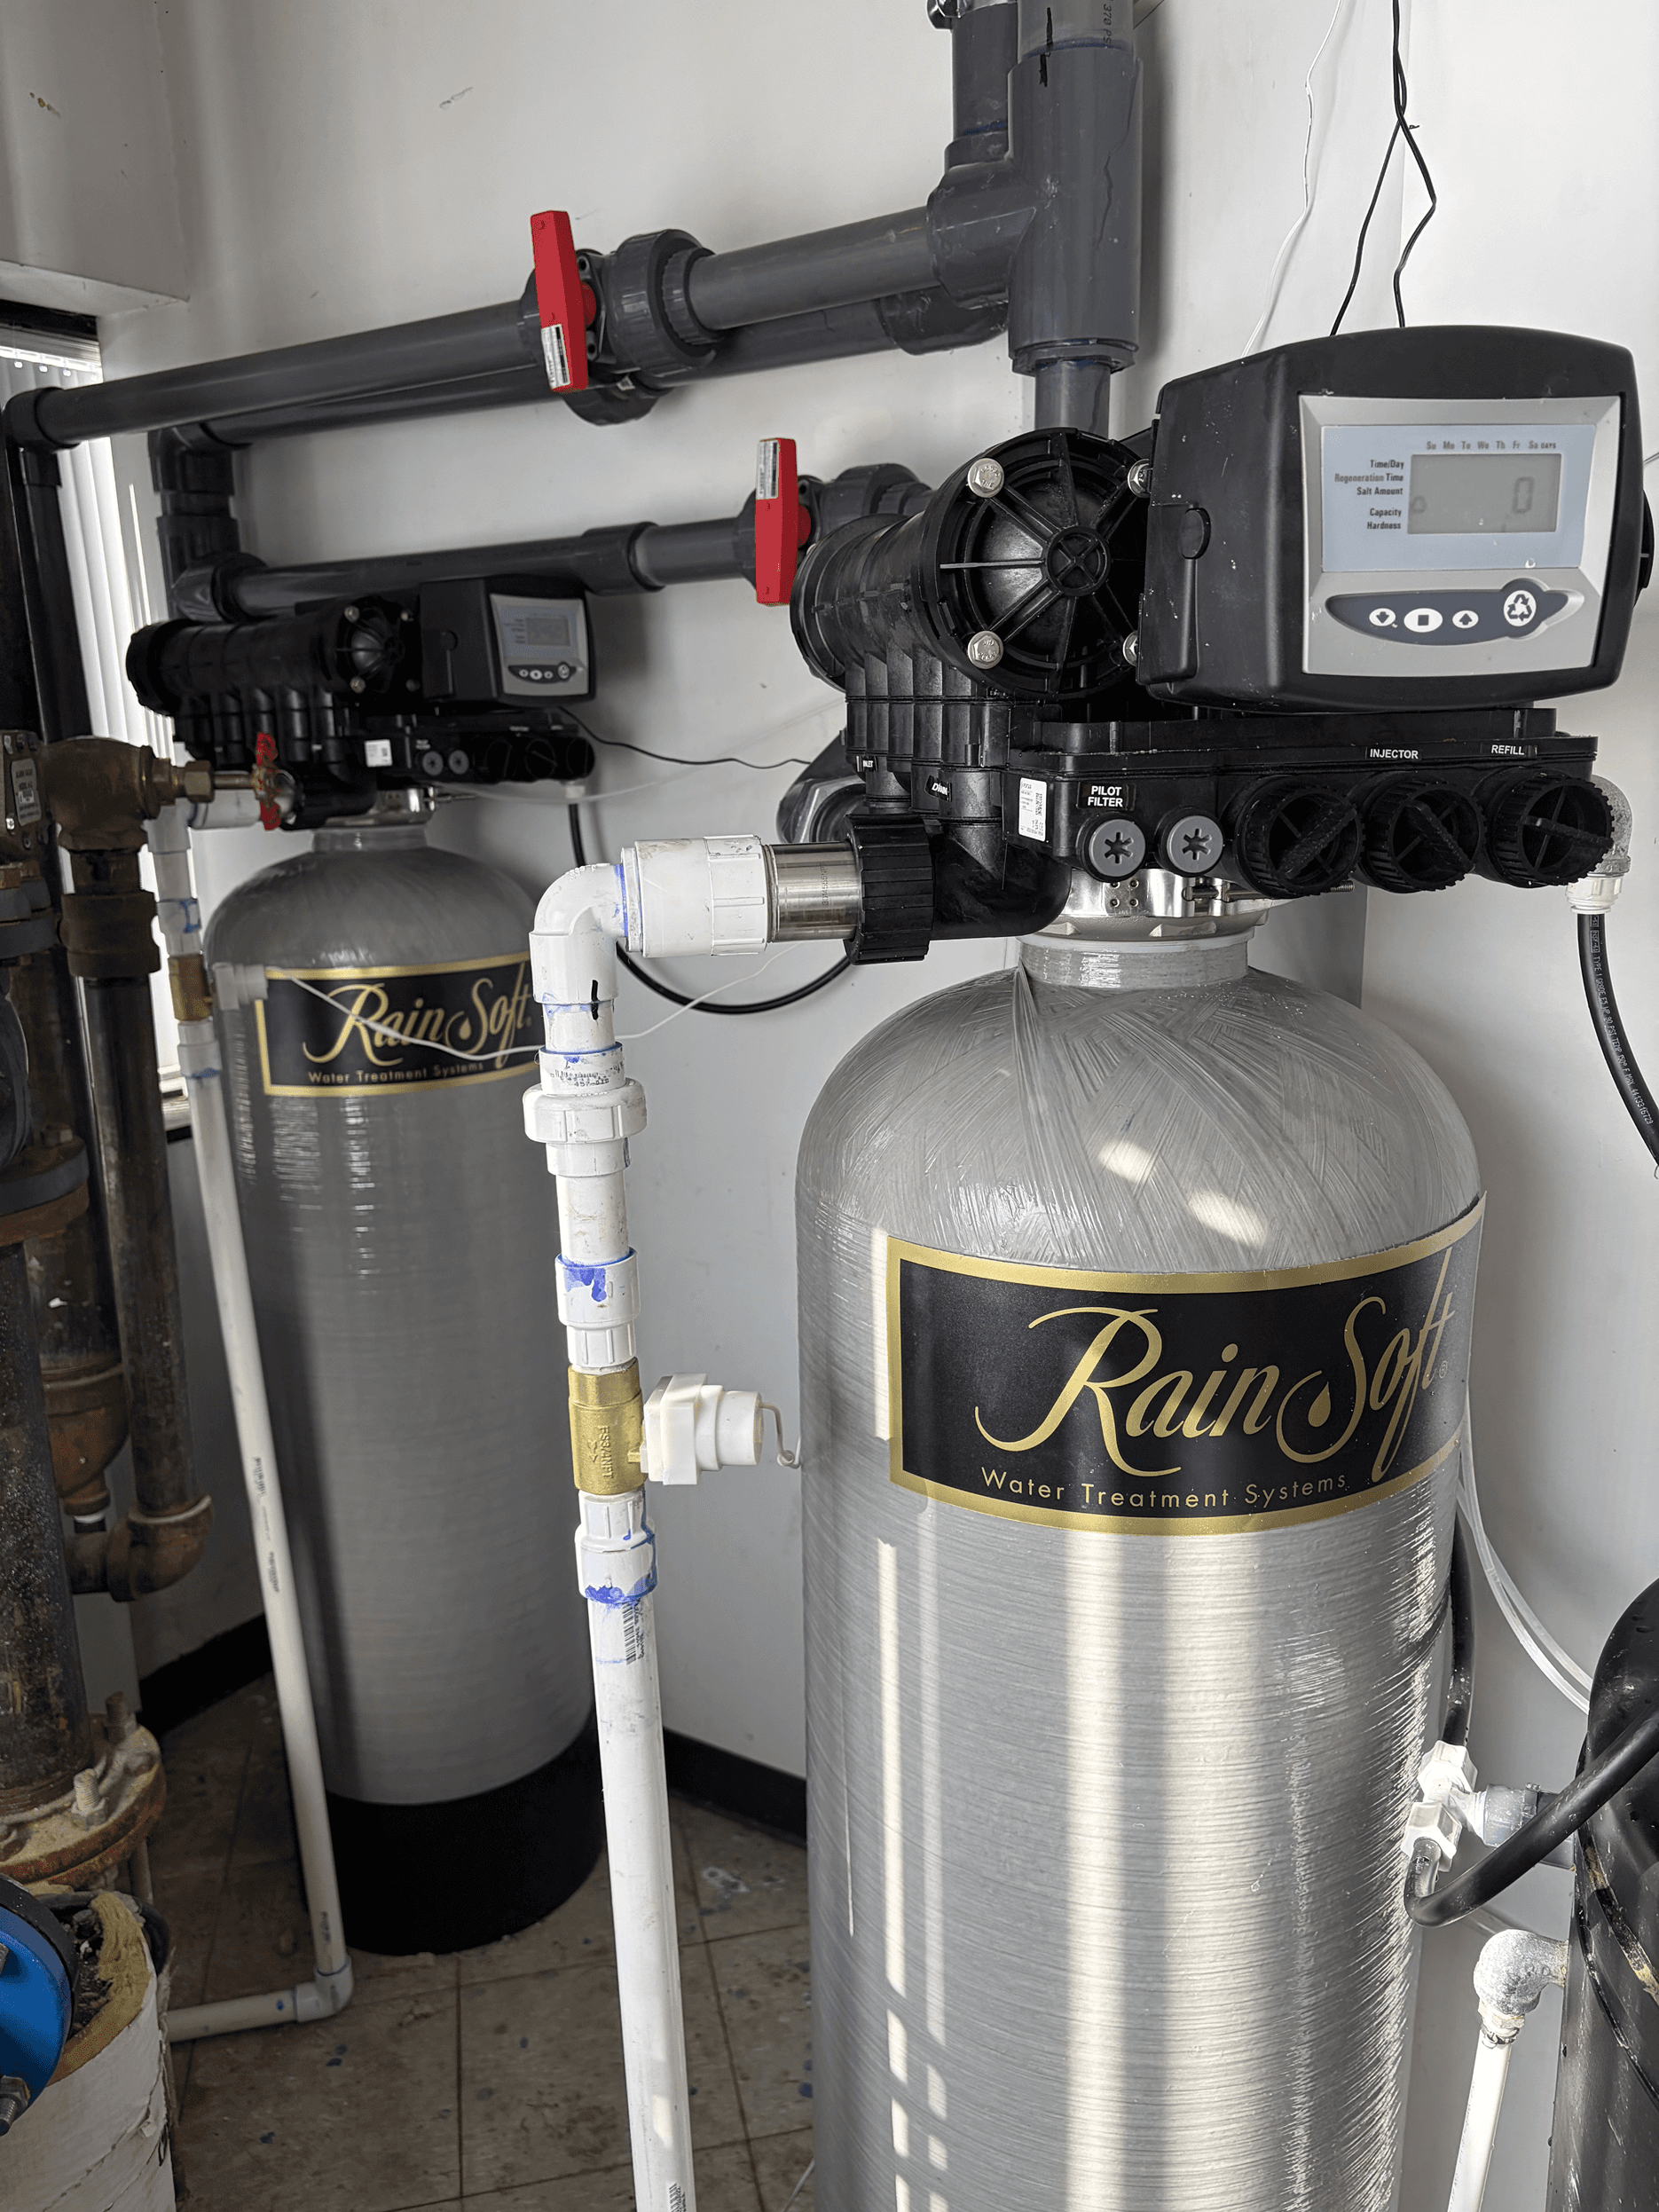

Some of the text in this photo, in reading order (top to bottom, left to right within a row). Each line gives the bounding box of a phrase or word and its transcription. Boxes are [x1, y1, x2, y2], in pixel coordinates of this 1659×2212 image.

[1103, 4, 1112, 46] 370 PS
[1426, 441, 1436, 450] Su
[1477, 441, 1490, 450] We
[1370, 459, 1404, 469] Time/Day
[1334, 472, 1404, 484] Regeneration Time
[1356, 486, 1403, 495] Salt Amount
[1369, 508, 1402, 517] Capacity
[1366, 521, 1402, 530] Hardness
[1369, 748, 1419, 760] INJECTOR
[1490, 744, 1525, 755] REFILL
[1090, 785, 1122, 796] PILOT
[1087, 796, 1123, 807] FILTER
[1592, 956, 1602, 972] TYPE
[1607, 1025, 1617, 1036] PSI
[1611, 1037, 1623, 1053] TEMP
[308, 1062, 484, 1083] Water Treatment Systems
[980, 1467, 1347, 1507] Water Treatment Systems
